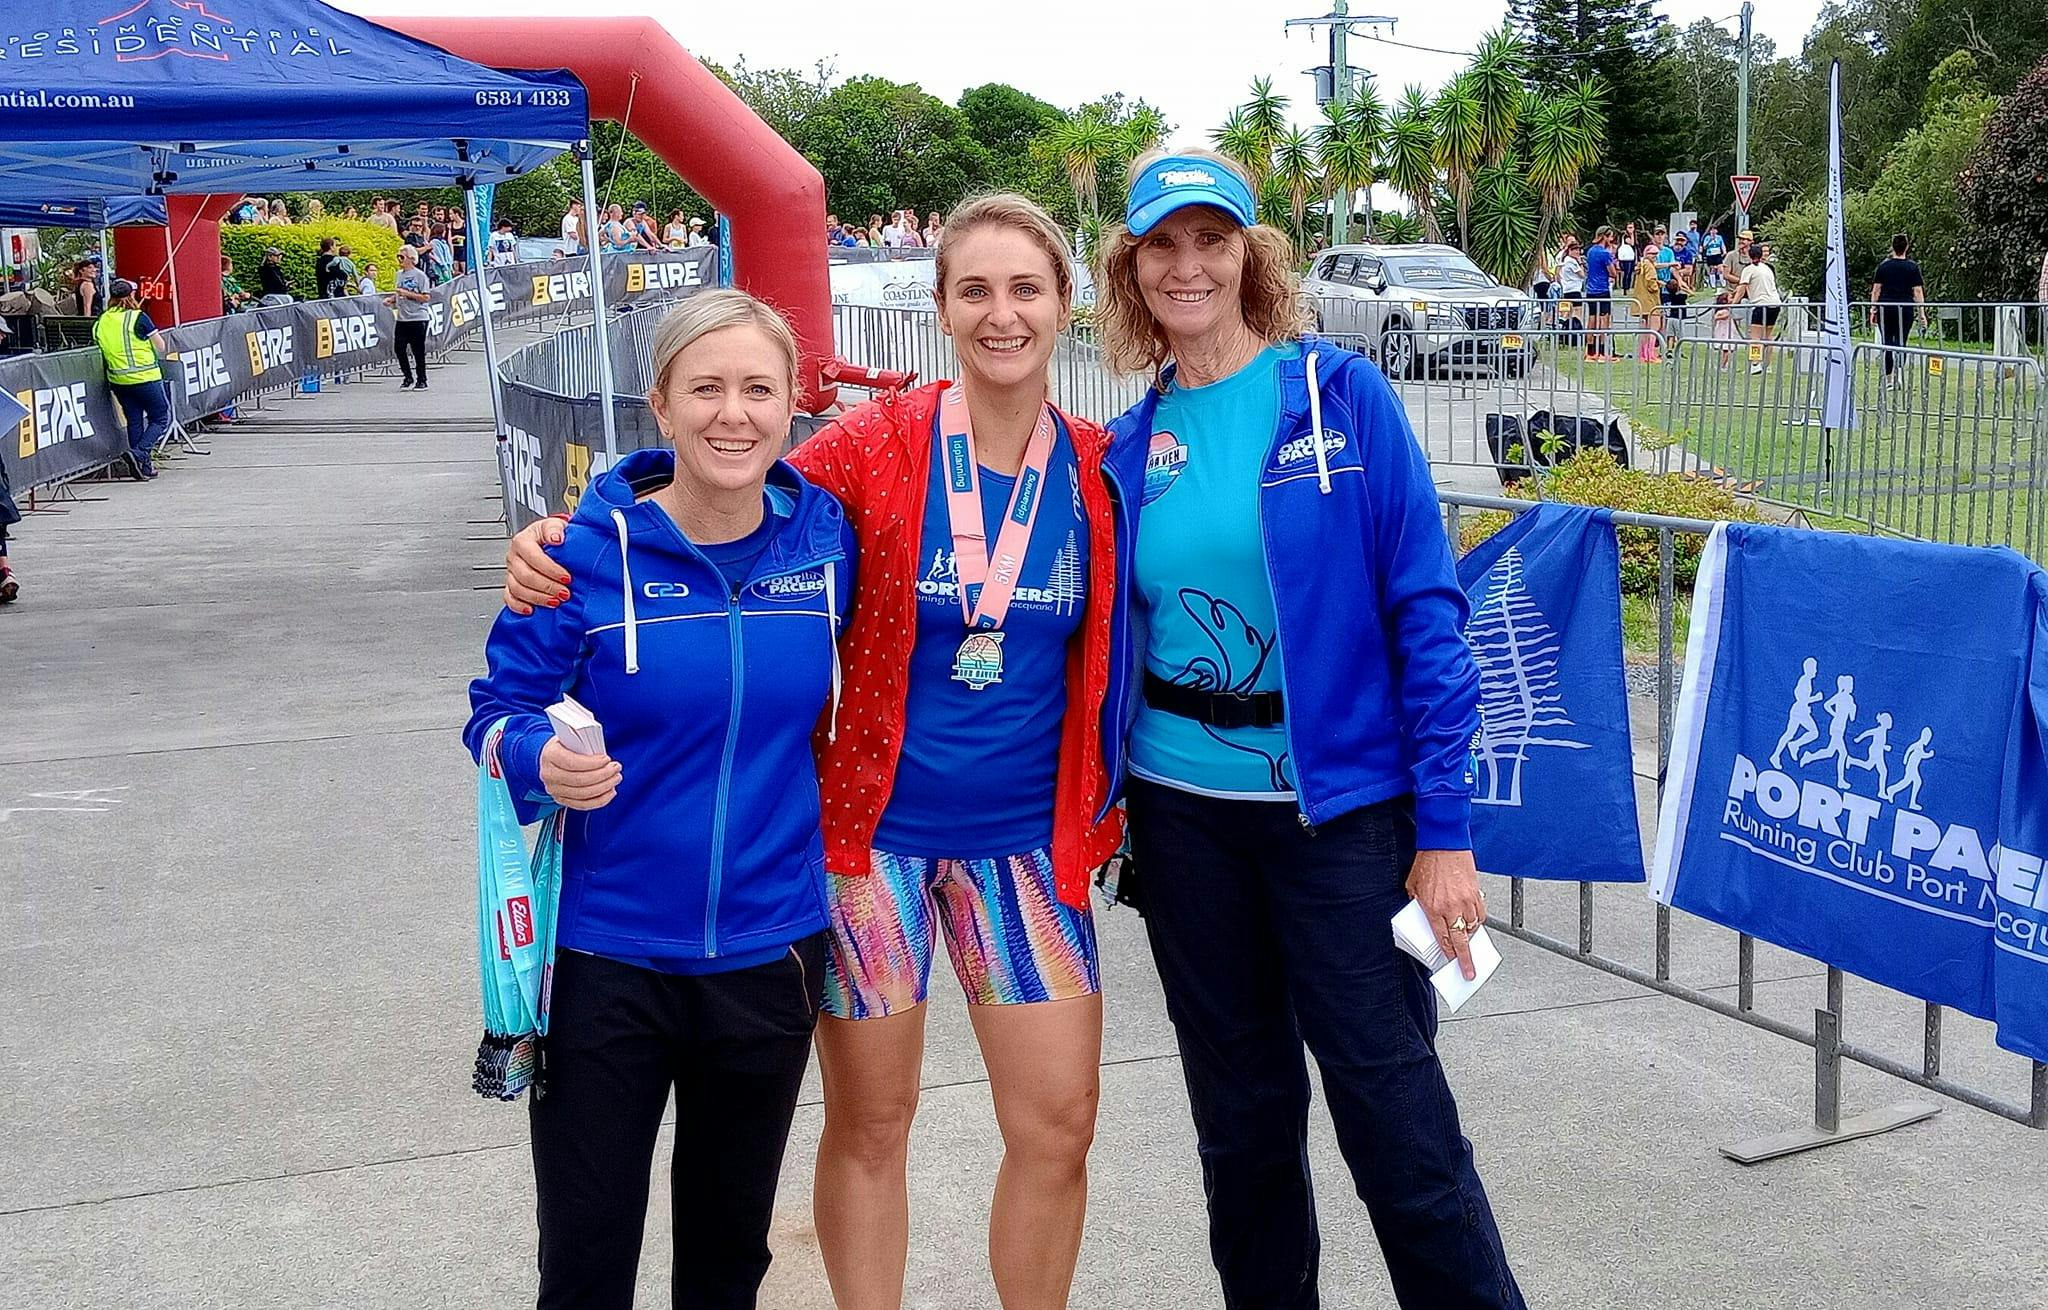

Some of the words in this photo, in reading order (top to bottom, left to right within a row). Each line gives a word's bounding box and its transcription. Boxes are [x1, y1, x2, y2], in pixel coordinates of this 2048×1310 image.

[8, 27, 100, 45] PORT
[117, 15, 321, 40] MACQUARIE
[475, 90, 523, 106] 6584
[527, 90, 571, 107] 4133
[626, 261, 701, 293] BEIRE
[882, 288, 933, 302] COASTLIN
[1277, 436, 1346, 466] PACRS
[1278, 436, 1315, 456] ORT
[1067, 462, 1082, 522] 2XU
[993, 553, 1016, 586] 5KM
[768, 579, 825, 595] PACERS
[1728, 753, 1882, 846] PORT
[1722, 799, 1818, 865] Running
[1826, 839, 1895, 884] Club
[1905, 863, 1968, 906] Port
